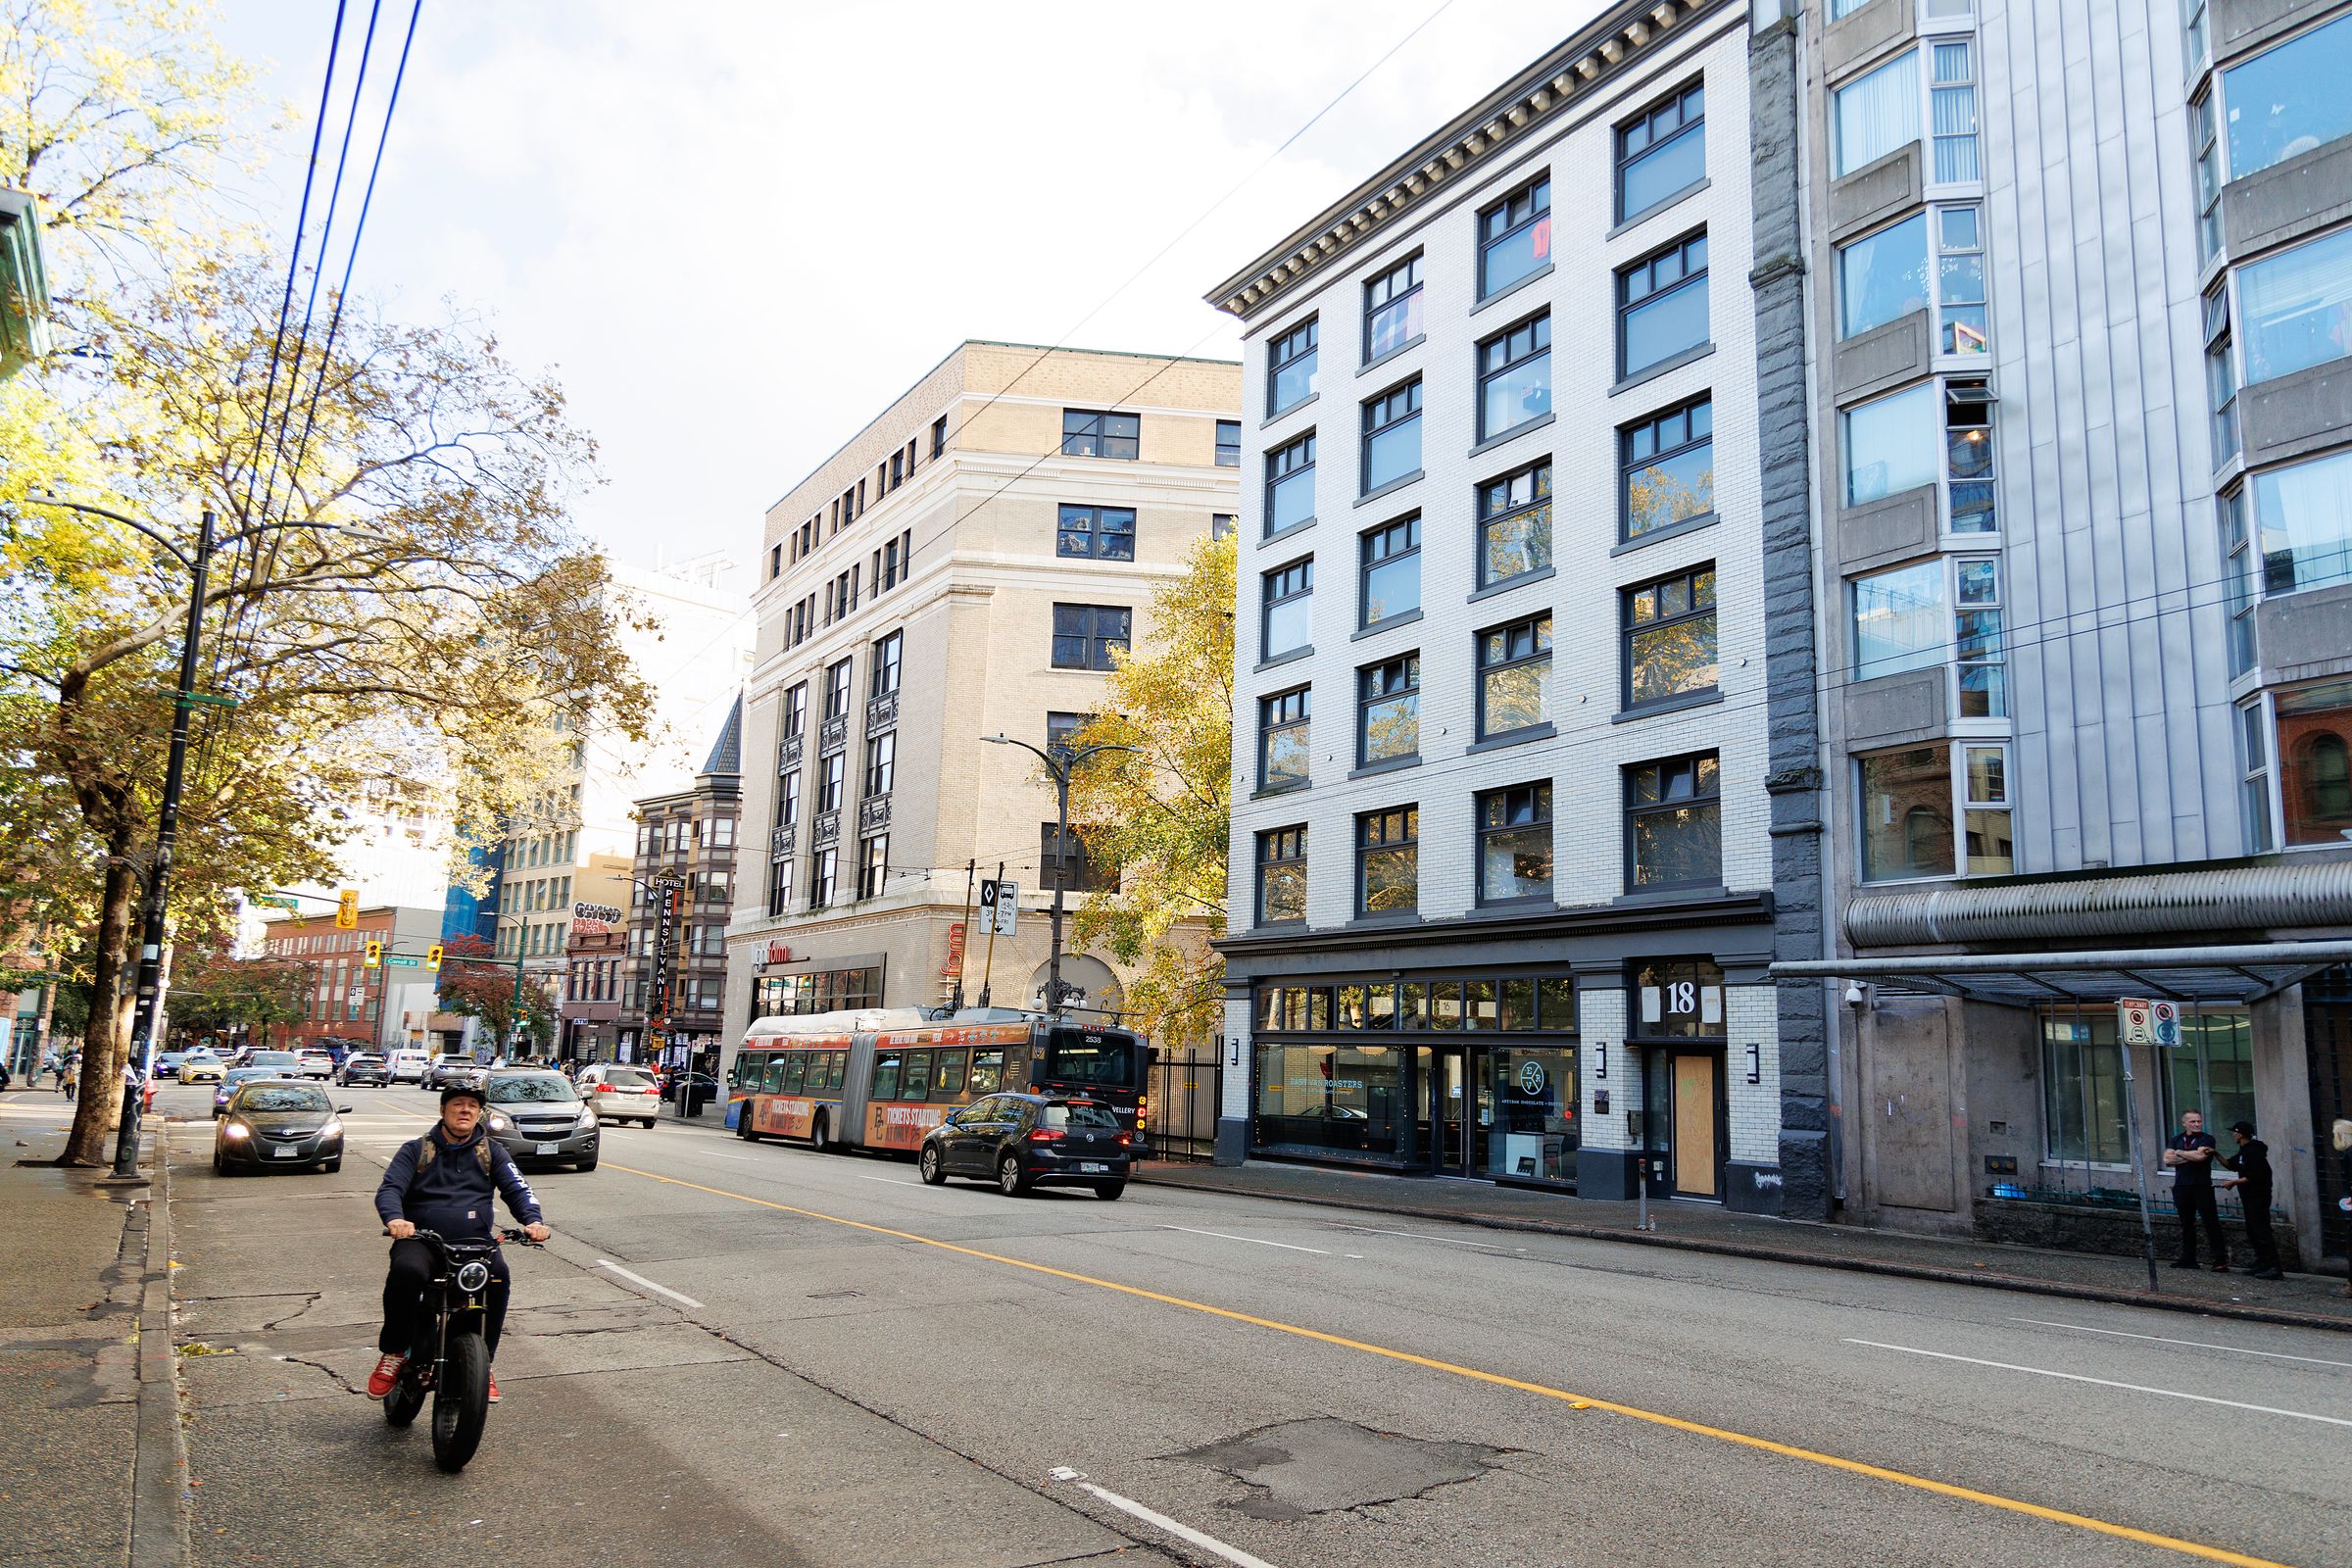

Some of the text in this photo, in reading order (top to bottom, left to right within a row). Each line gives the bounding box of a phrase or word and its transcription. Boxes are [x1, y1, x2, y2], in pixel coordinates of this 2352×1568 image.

[655, 878, 684, 888] HOTEL
[657, 889, 673, 1004] PENNSYLVANI
[1666, 981, 1695, 1013] 18
[1443, 1002, 1450, 1011] 16
[1324, 1079, 1363, 1089] ROASTERS
[887, 1107, 941, 1127] TICKETS STARTING
